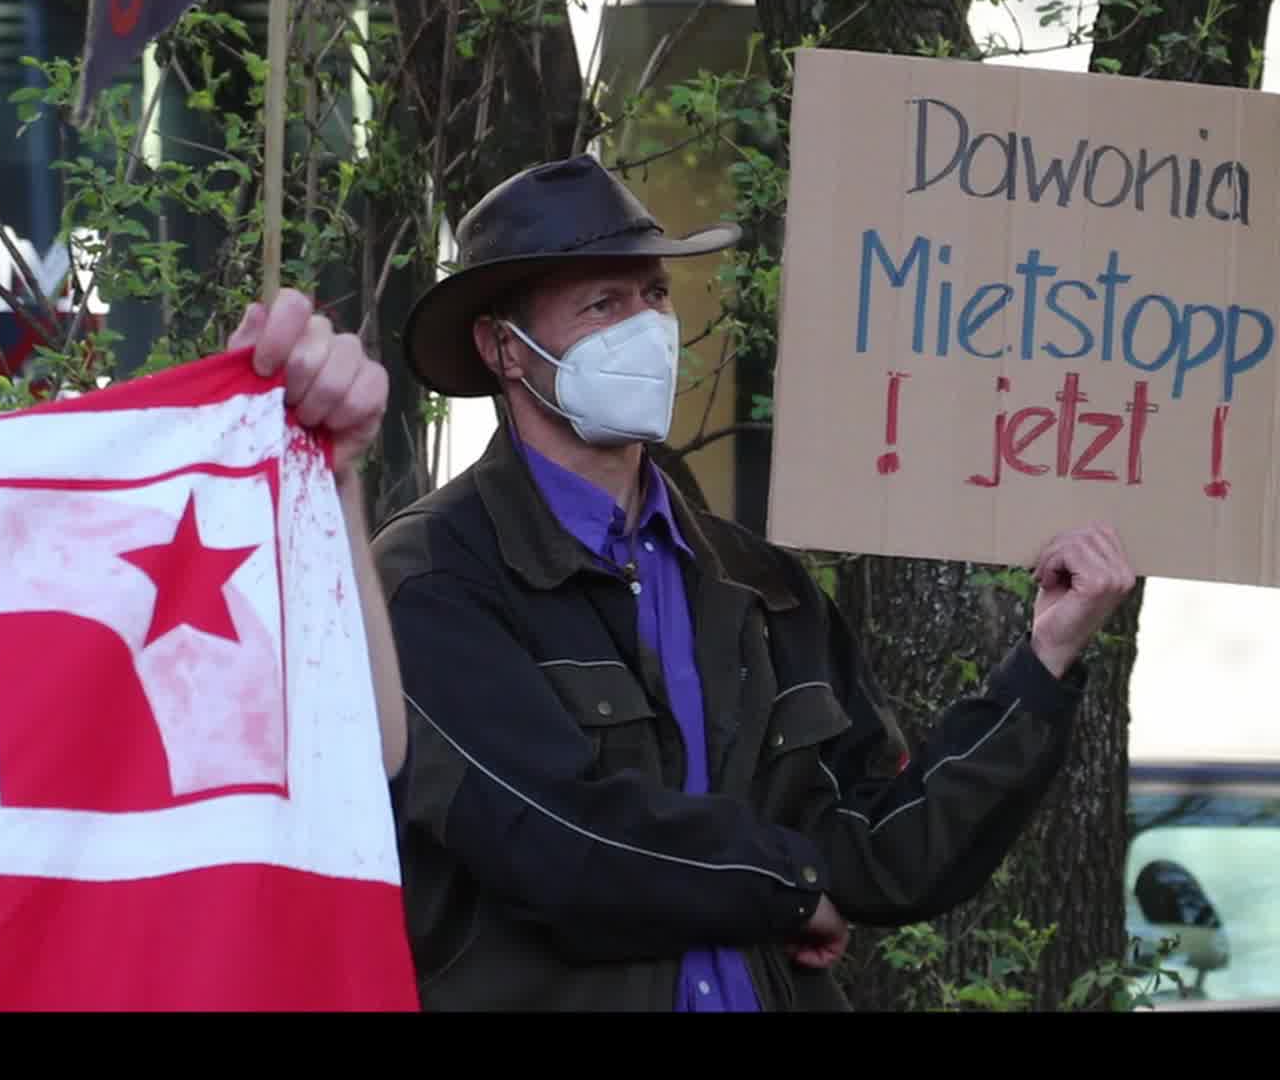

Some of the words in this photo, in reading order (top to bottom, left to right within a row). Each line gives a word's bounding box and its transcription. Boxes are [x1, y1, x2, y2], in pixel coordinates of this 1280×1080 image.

[905, 98, 1250, 226] Dawonia
[855, 229, 1275, 402] Mietstopp
[963, 372, 1160, 487] jetzt
